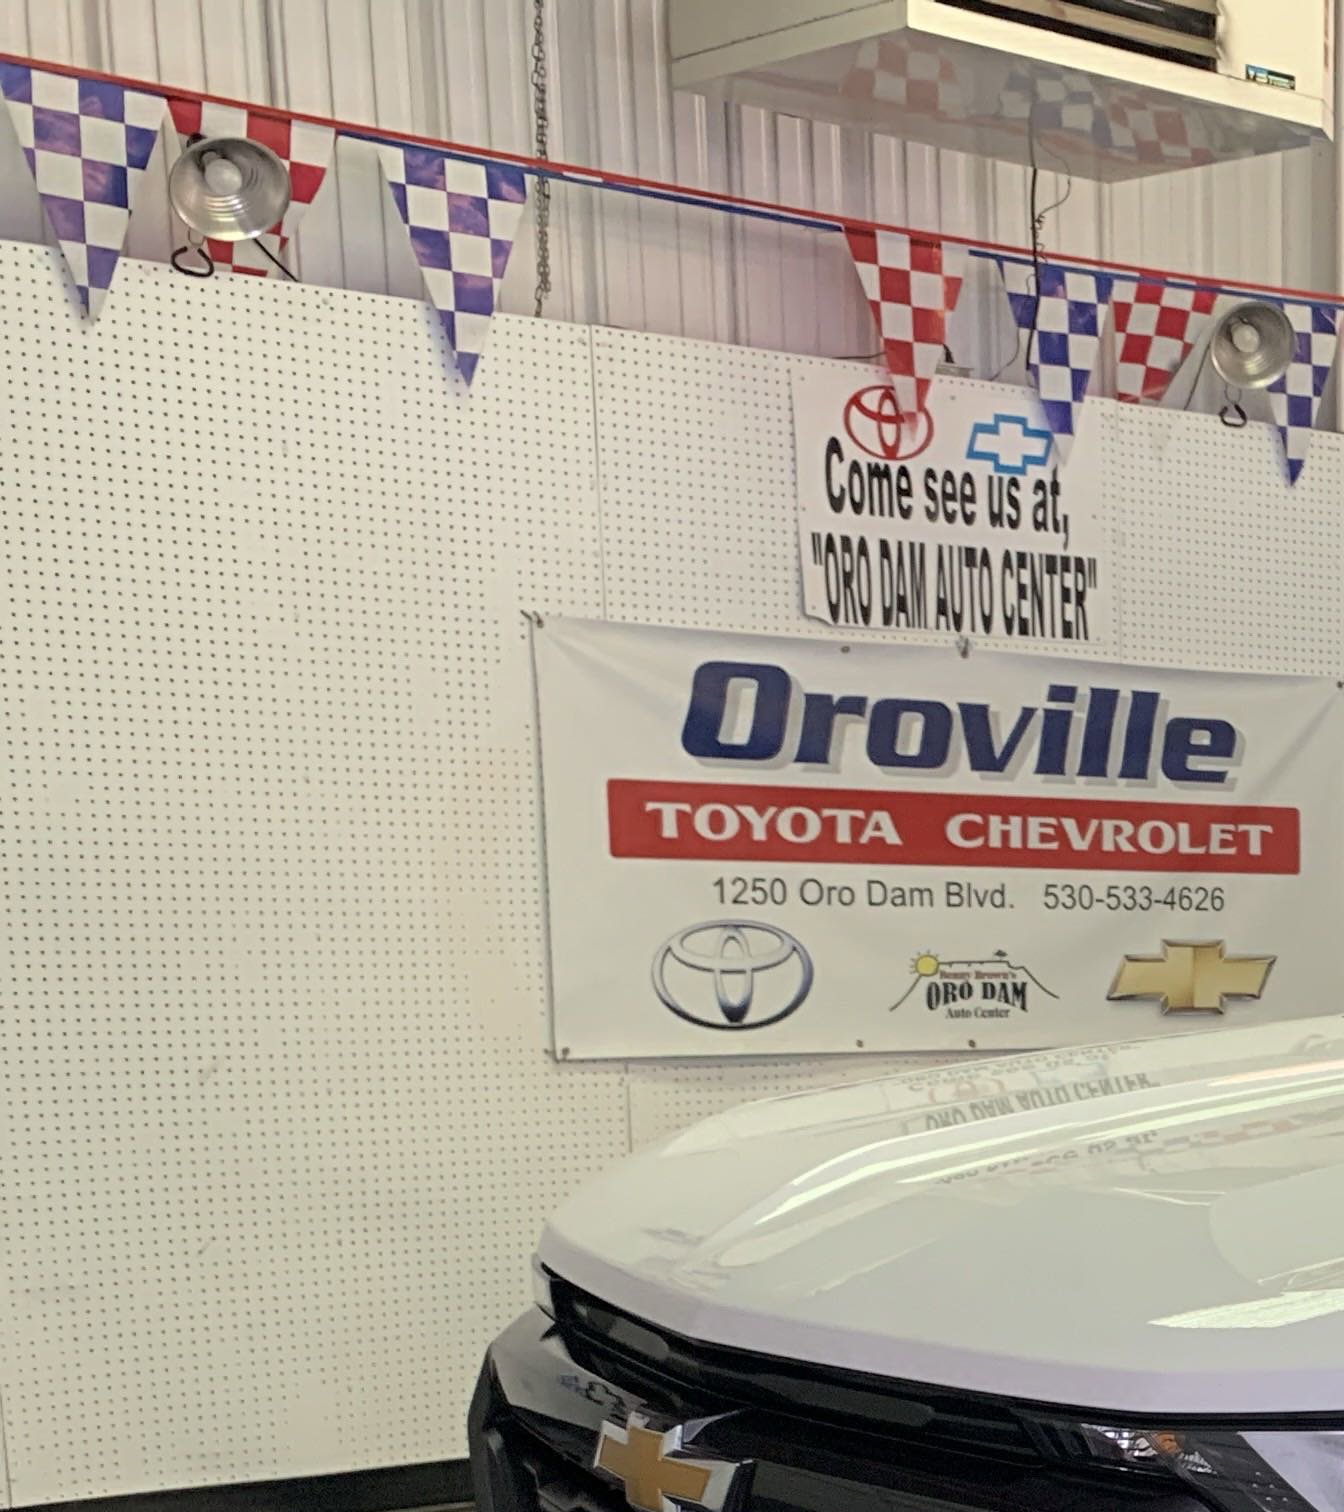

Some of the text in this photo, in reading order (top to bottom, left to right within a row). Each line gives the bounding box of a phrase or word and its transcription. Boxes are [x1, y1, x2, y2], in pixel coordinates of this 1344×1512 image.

[825, 436, 1069, 549] Come see us at,
[879, 538, 928, 629] DAM
[936, 545, 993, 635] AUTO
[681, 660, 1240, 786] Oroville
[645, 801, 1274, 857] TOYOTA CHEVROLET
[711, 876, 1226, 912] 1250 Oro Dam Blvd. 530-533-4626
[926, 980, 1028, 1013] ORO DAM
[945, 1006, 1010, 1019] Auto Center
